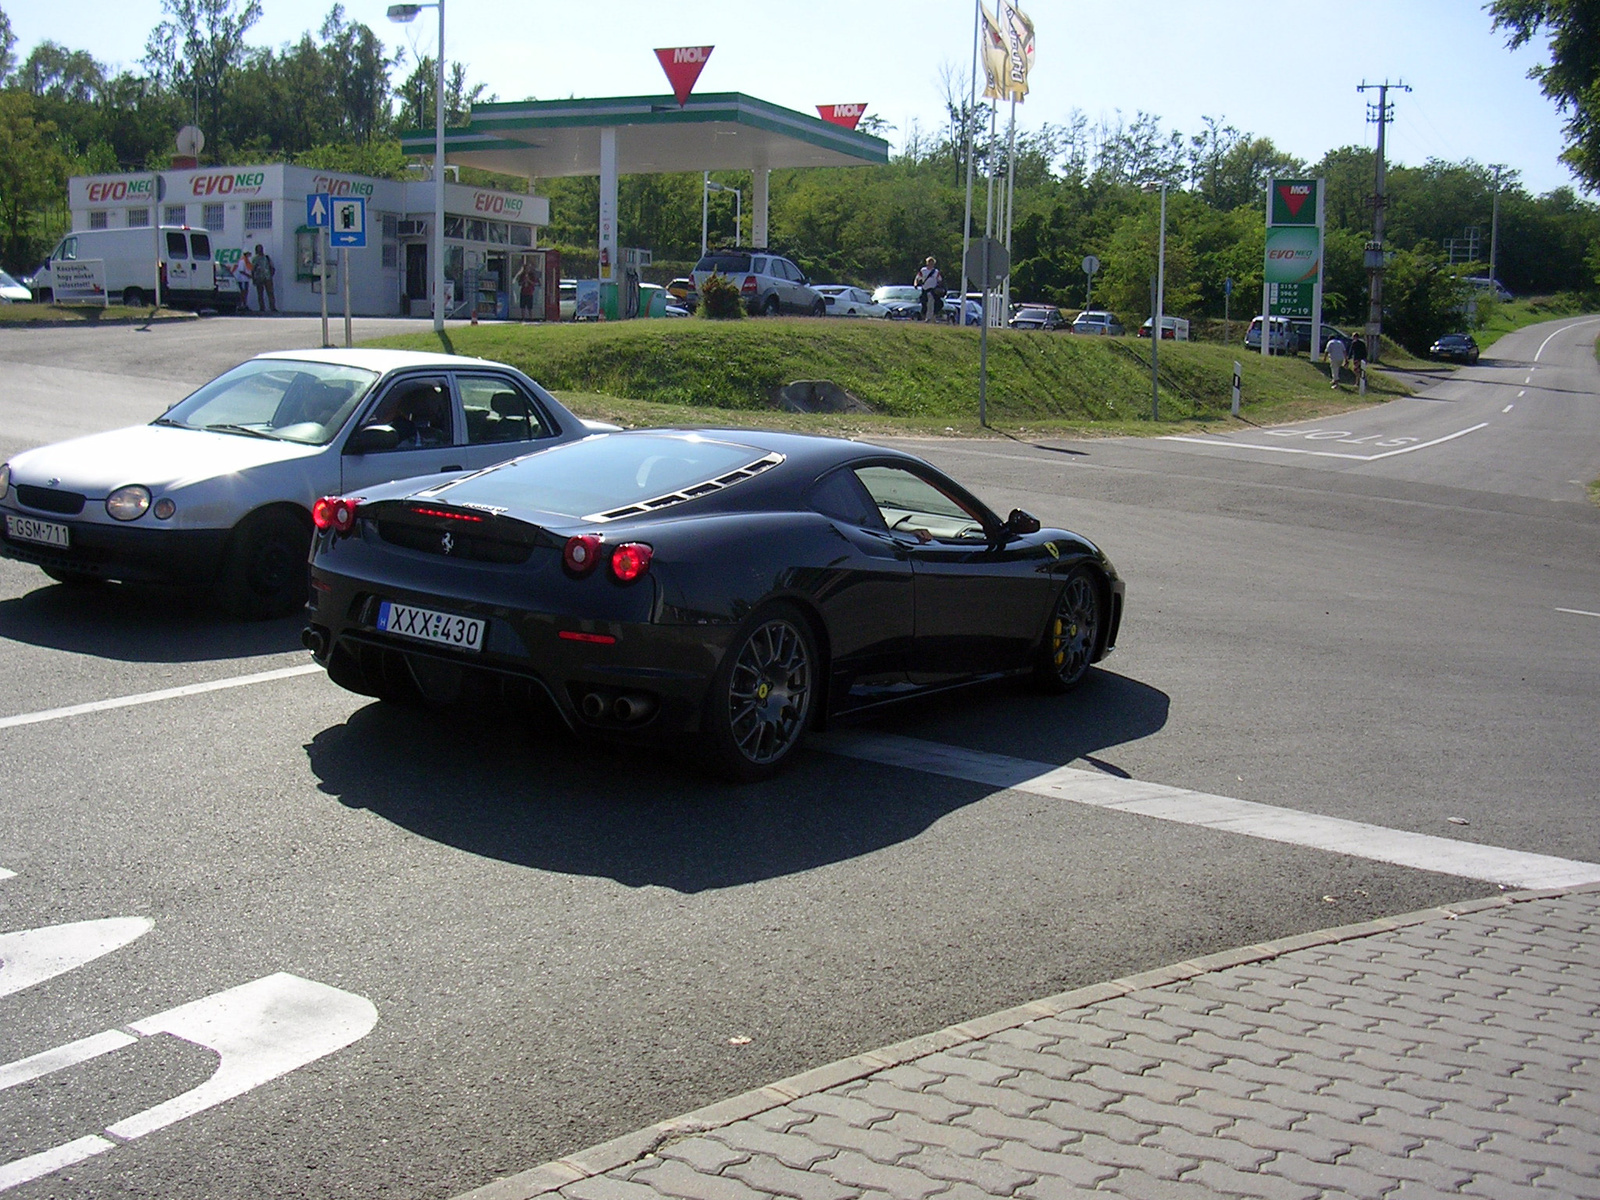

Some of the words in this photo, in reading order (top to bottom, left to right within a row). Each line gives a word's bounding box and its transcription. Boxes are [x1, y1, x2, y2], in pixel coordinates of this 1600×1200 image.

[673, 48, 707, 63] MOL
[833, 104, 862, 118] MOL
[88, 181, 128, 202] EVO
[192, 174, 235, 197] EVO
[235, 173, 265, 187] NEO
[350, 181, 374, 196] NEO
[1290, 185, 1311, 195] MOL
[475, 193, 503, 214] EVO
[503, 198, 524, 210] NEO
[1269, 249, 1295, 260] EVO
[1280, 307, 1309, 315] 07-19
[16, 519, 68, 544] GSM-711
